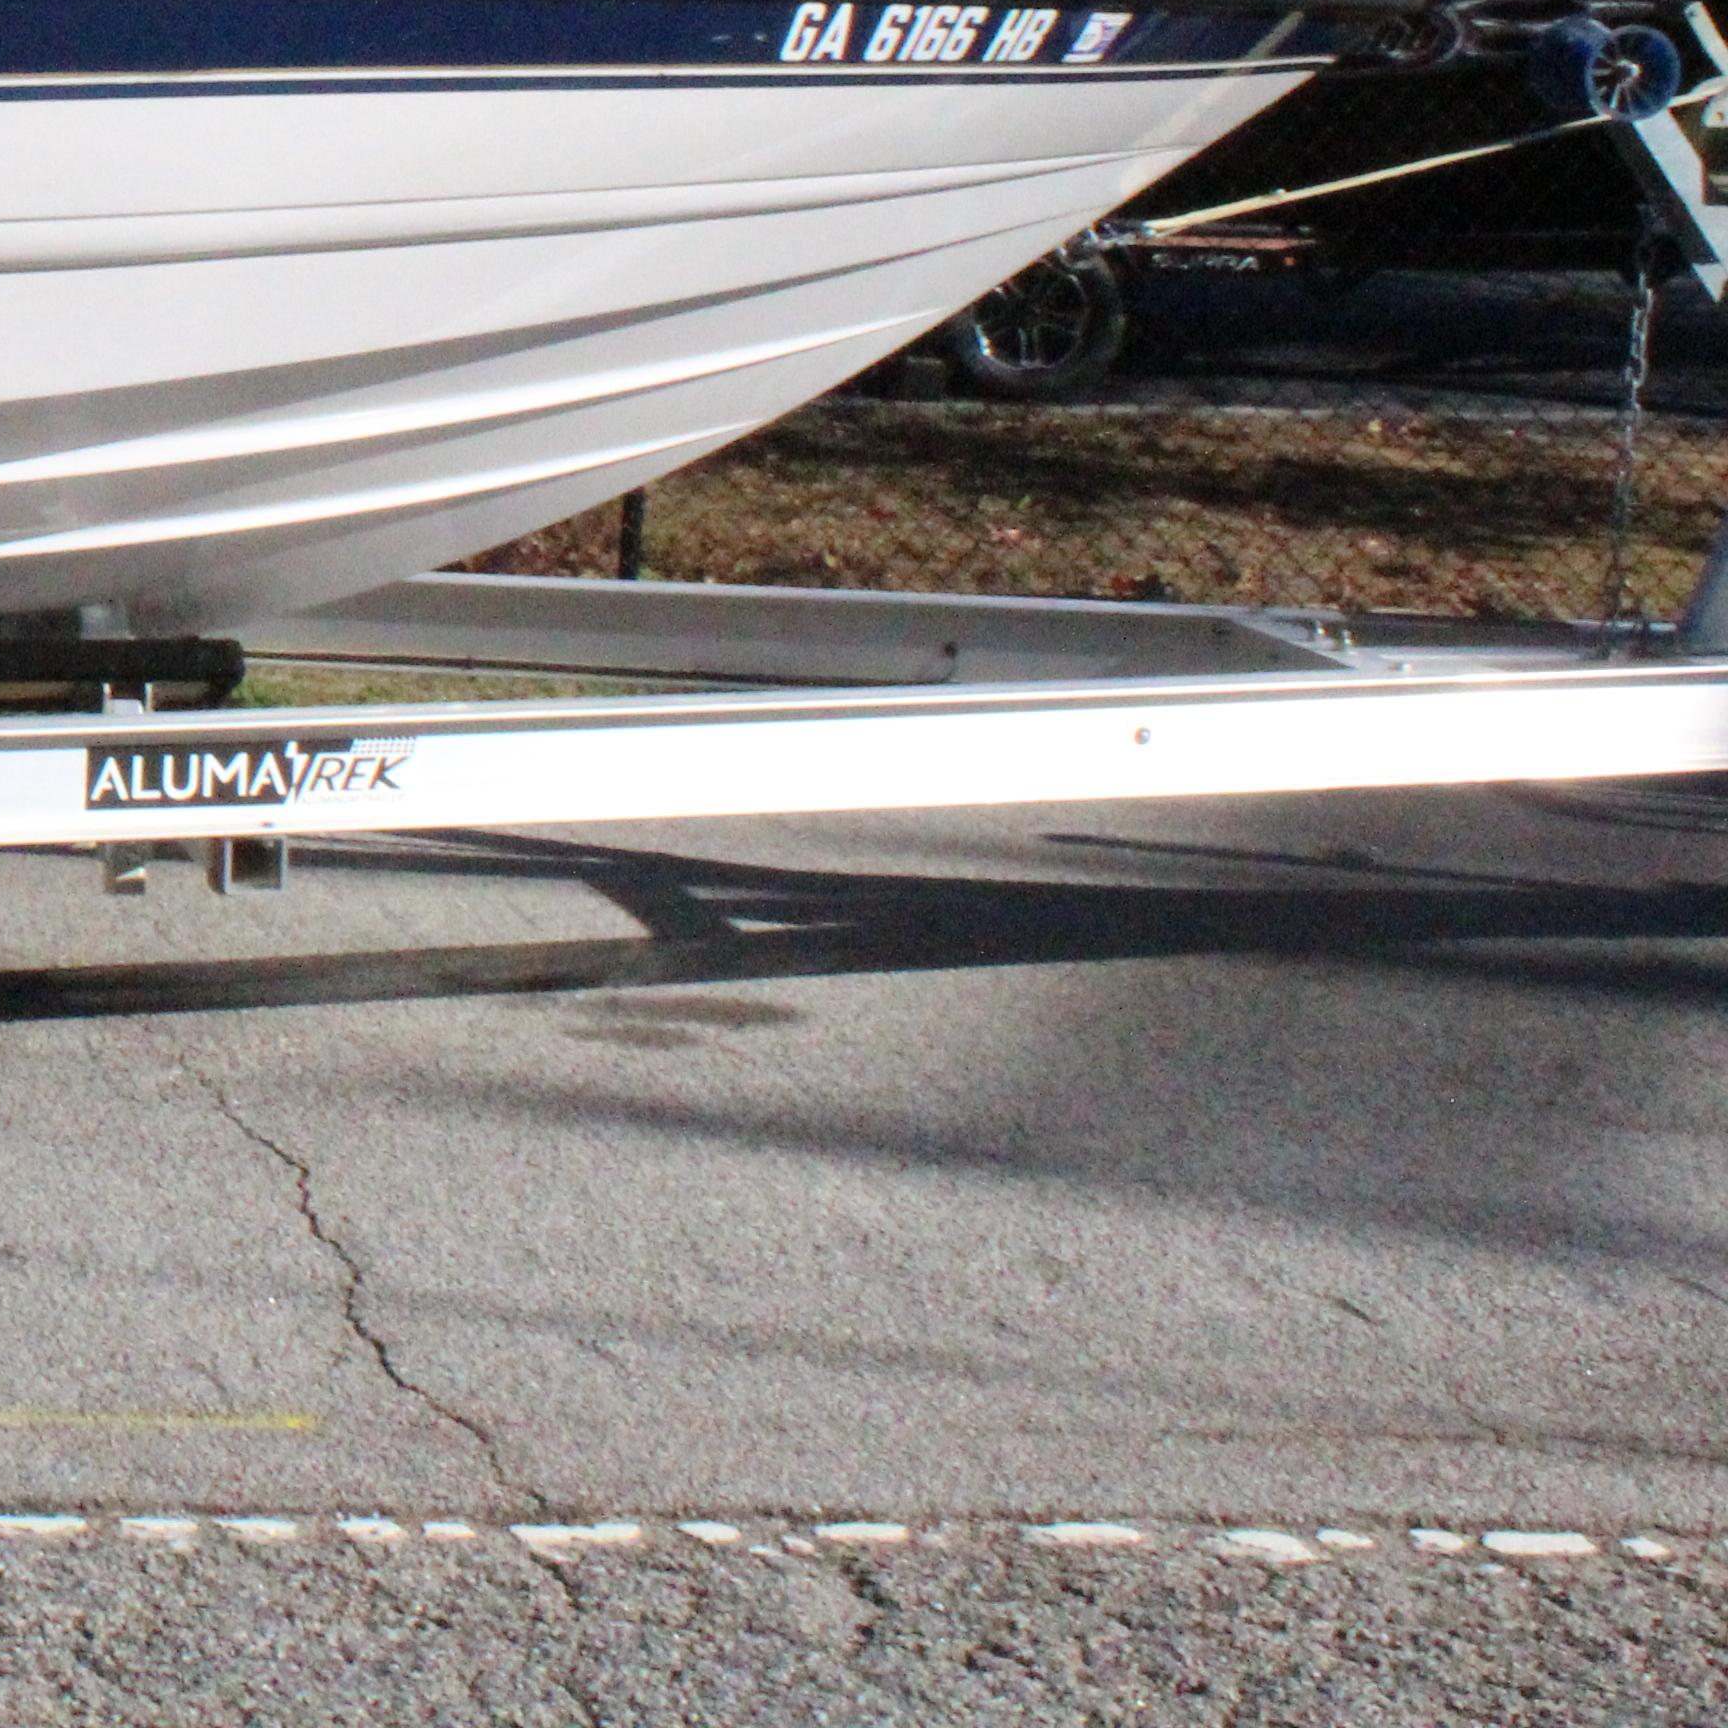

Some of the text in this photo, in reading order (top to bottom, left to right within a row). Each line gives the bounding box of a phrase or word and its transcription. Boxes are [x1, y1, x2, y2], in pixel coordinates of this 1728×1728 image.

[779, 1, 855, 62] GA
[863, 3, 990, 63] 6166
[981, 8, 1060, 63] HB
